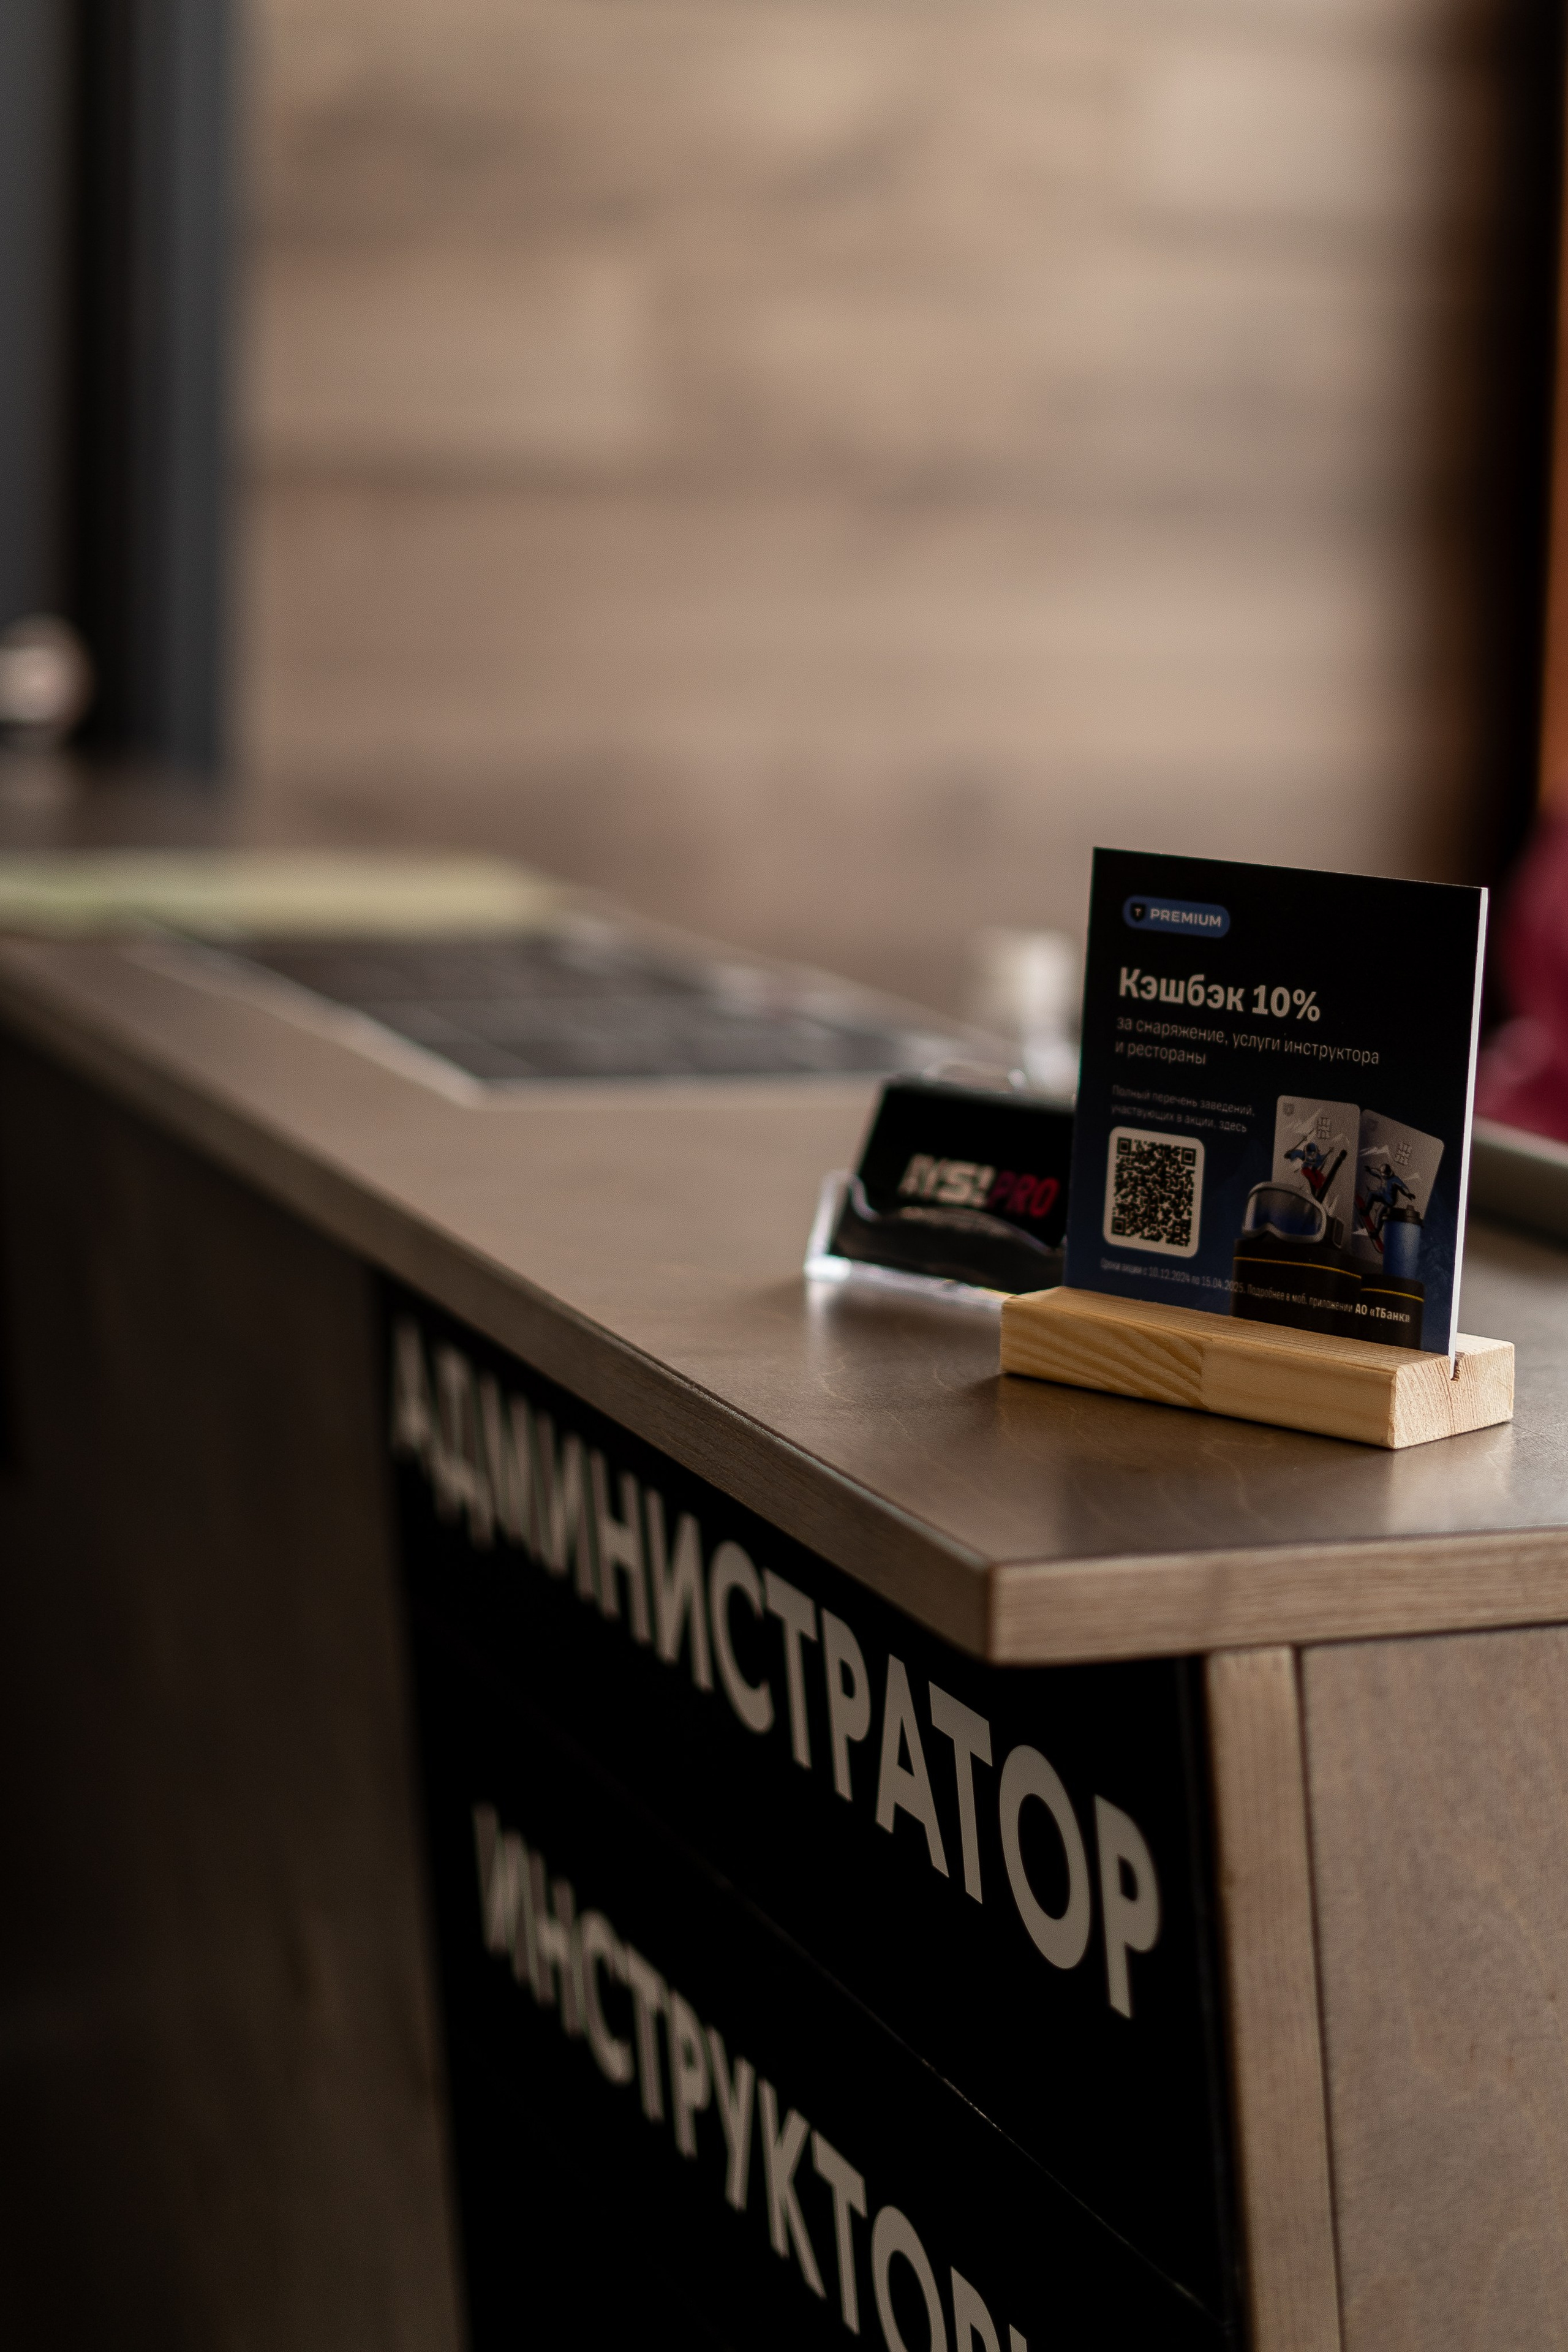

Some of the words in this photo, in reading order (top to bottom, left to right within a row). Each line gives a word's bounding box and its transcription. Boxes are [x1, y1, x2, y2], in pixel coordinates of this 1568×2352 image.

[1150, 908, 1222, 928] PREMIUM
[1118, 967, 1245, 1012] Кэшбэк
[1251, 984, 1321, 1022] 10%
[1115, 1041, 1125, 1054] и
[1127, 1042, 1207, 1066] рестораны
[1116, 1017, 1132, 1030] за
[1136, 1019, 1229, 1046] снаряжение,
[1232, 1033, 1281, 1052] услуги
[1284, 1040, 1379, 1066] инструктора
[1111, 1104, 1174, 1121] участвующих
[1184, 1114, 1216, 1129] акции,
[1219, 1120, 1247, 1133] здесь
[1112, 1084, 1150, 1100] Полный
[1152, 1093, 1198, 1107] перечень
[1200, 1099, 1256, 1117] заведений,
[1247, 1284, 1284, 1302] Подробнее
[1286, 1292, 1290, 1301] в
[1292, 1292, 1308, 1305] моб.
[1309, 1297, 1353, 1313] приложении
[1354, 1303, 1368, 1315] АО
[1369, 1306, 1410, 1323] «ТБанк»
[392, 1314, 1160, 2019] АДМИНИСТРАТОР
[473, 1801, 1029, 2352] ИНСТРУКТО
